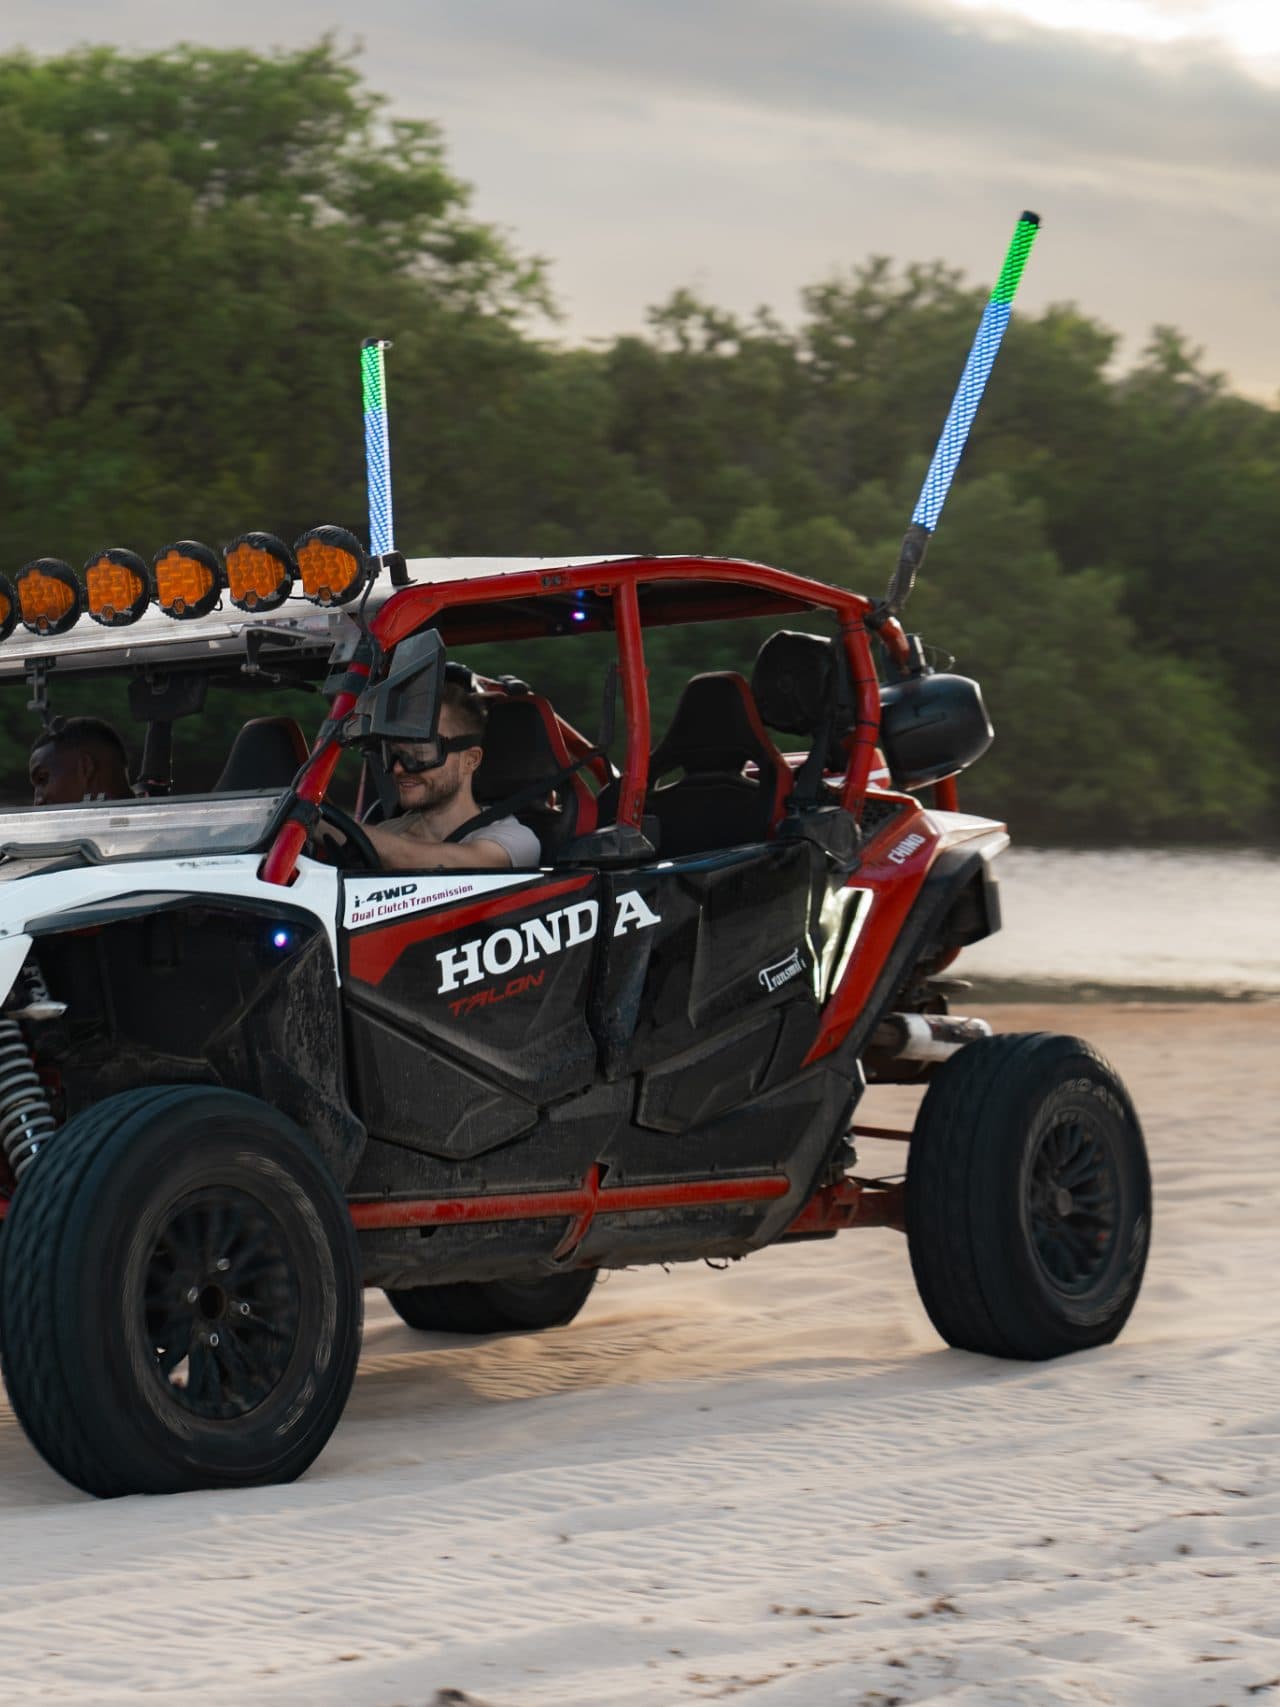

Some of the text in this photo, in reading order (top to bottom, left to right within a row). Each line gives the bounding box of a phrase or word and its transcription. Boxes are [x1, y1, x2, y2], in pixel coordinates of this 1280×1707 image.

[351, 884, 473, 923] Dual Clutch Transmission
[435, 890, 661, 994] HONDA
[448, 970, 545, 1017] TALON
